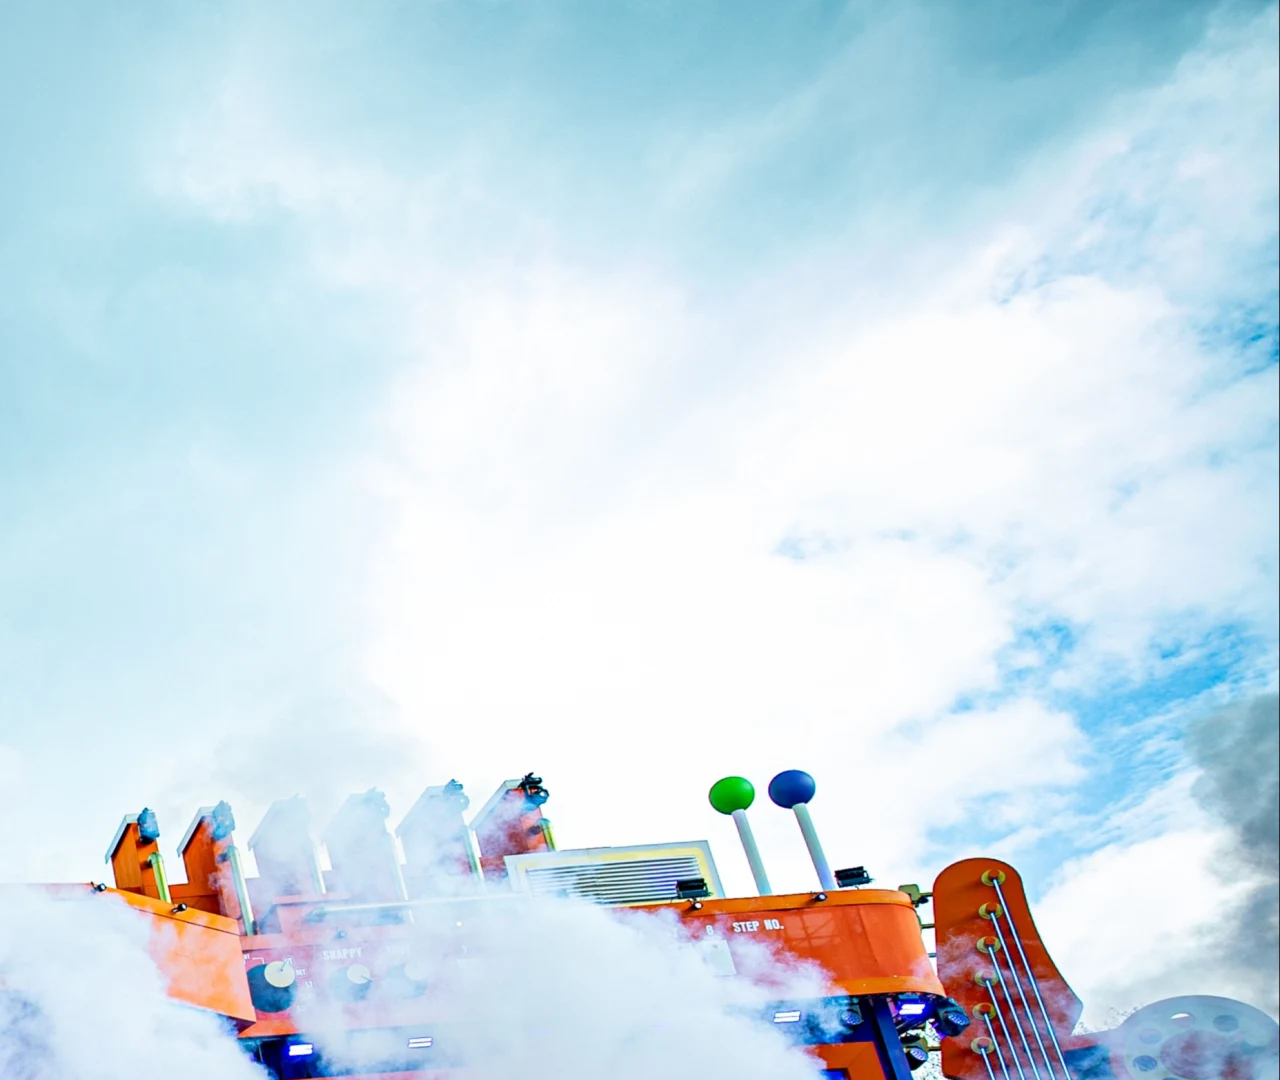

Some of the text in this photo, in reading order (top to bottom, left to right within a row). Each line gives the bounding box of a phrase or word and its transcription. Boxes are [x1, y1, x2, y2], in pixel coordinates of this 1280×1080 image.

[732, 919, 784, 933] STEP NO.
[323, 947, 362, 961] SNAPPY
